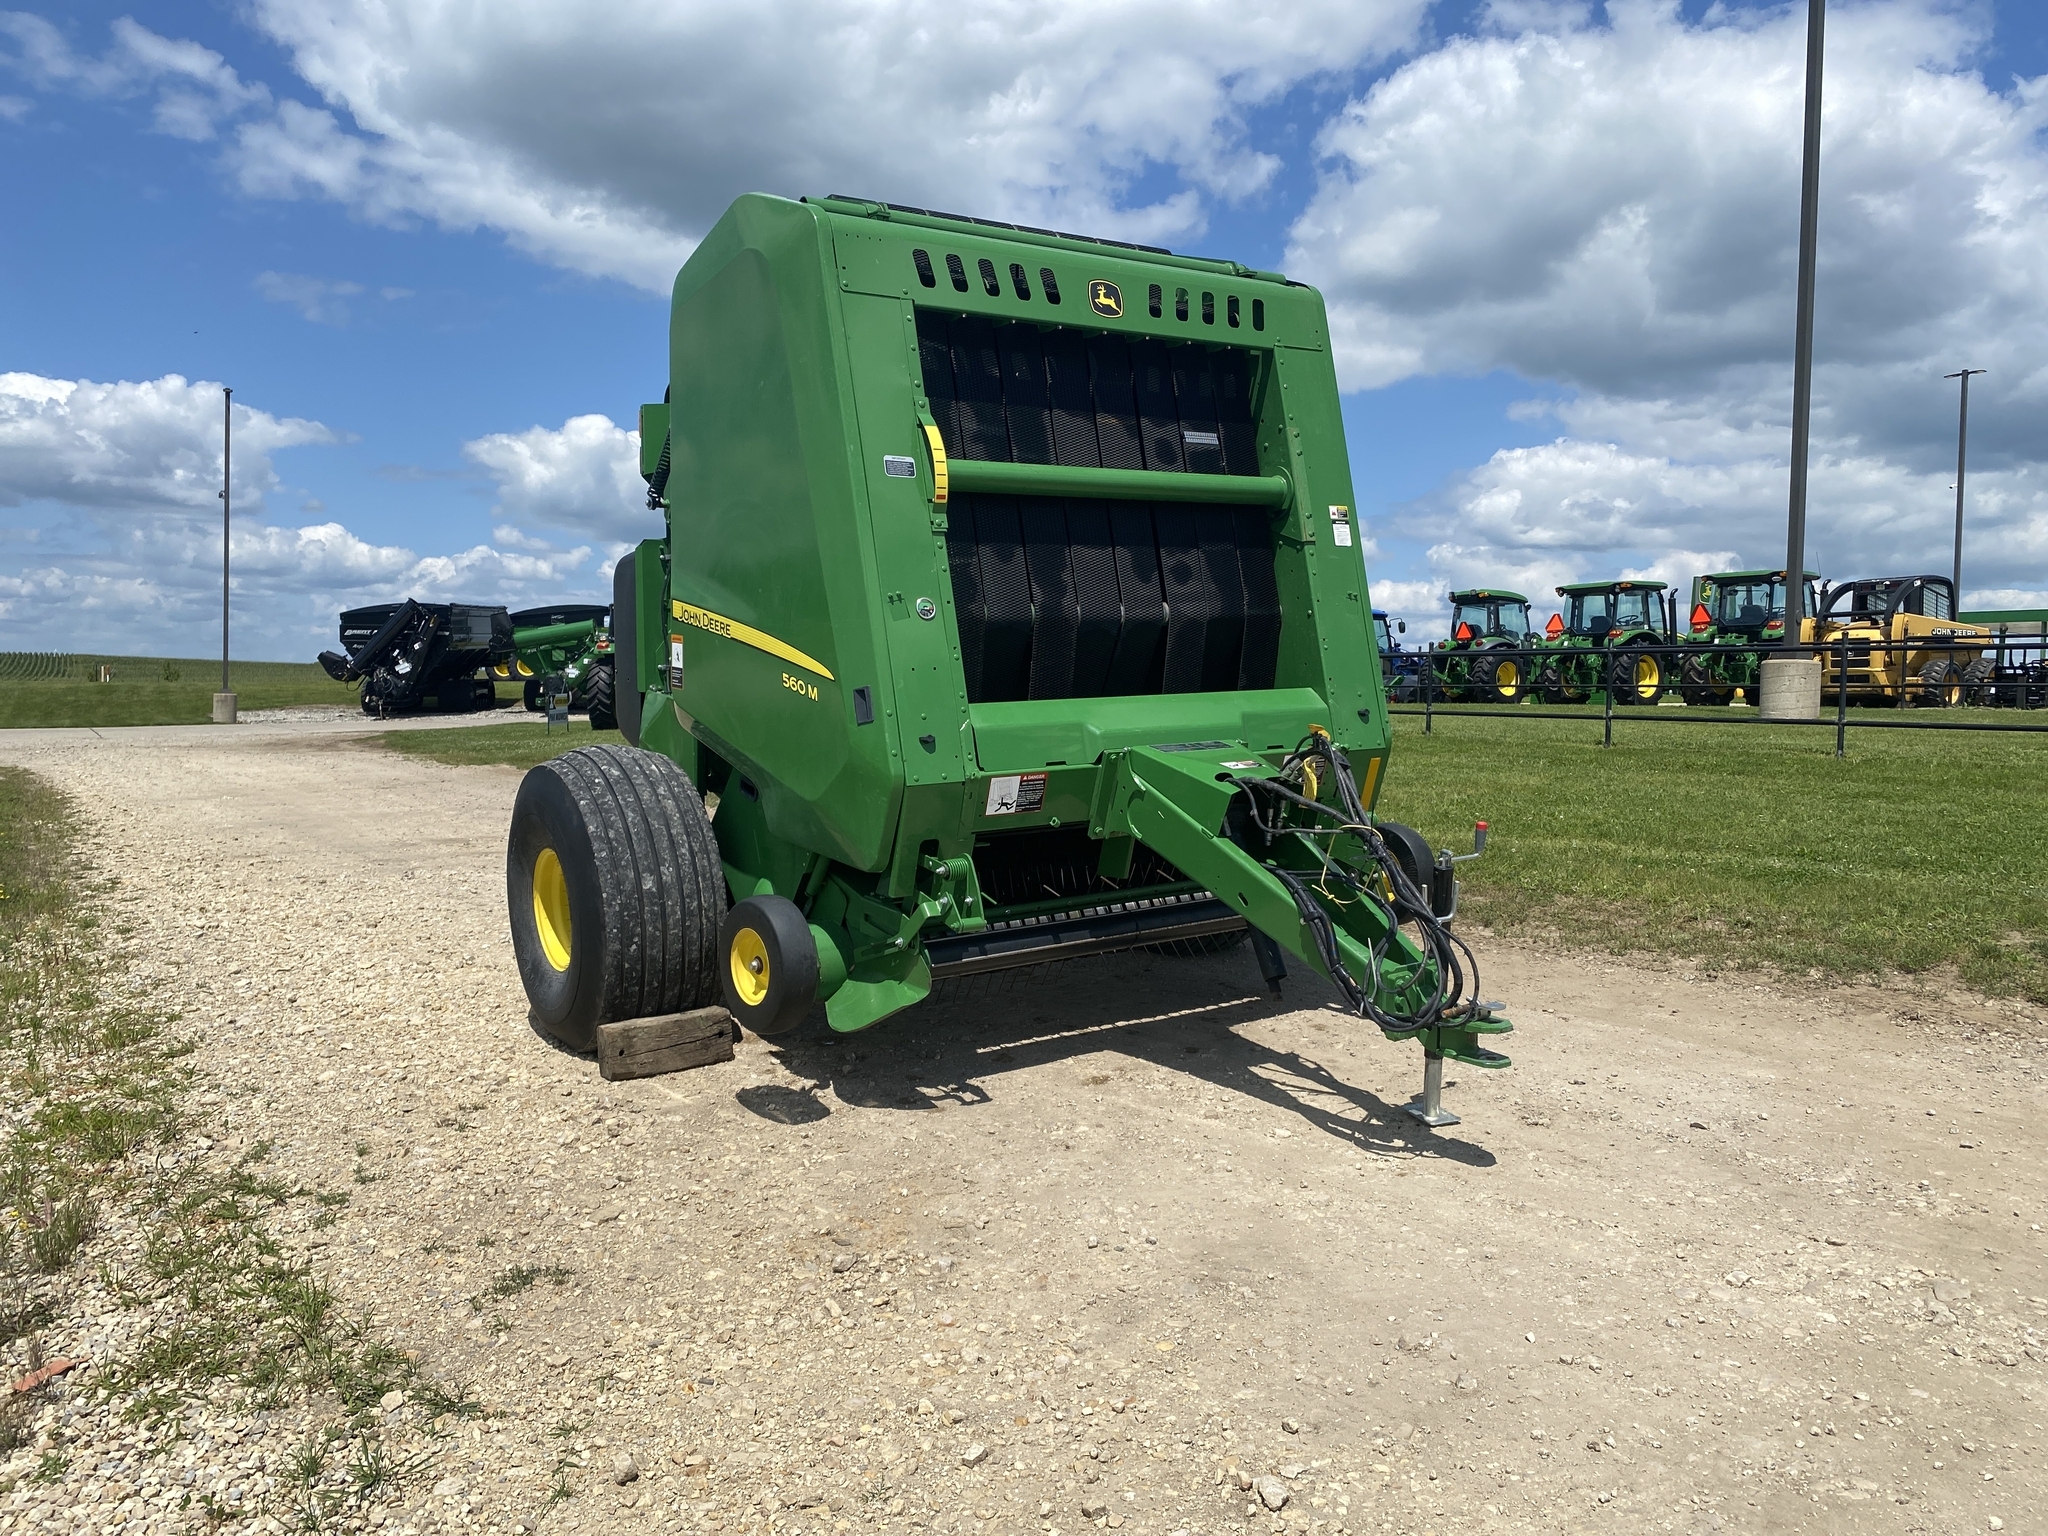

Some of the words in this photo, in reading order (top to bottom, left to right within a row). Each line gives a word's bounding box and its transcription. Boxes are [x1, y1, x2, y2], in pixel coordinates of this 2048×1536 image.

[679, 606, 702, 627] JOHN
[702, 613, 731, 637] DEERE
[782, 672, 806, 695] 560
[808, 684, 818, 701] M
